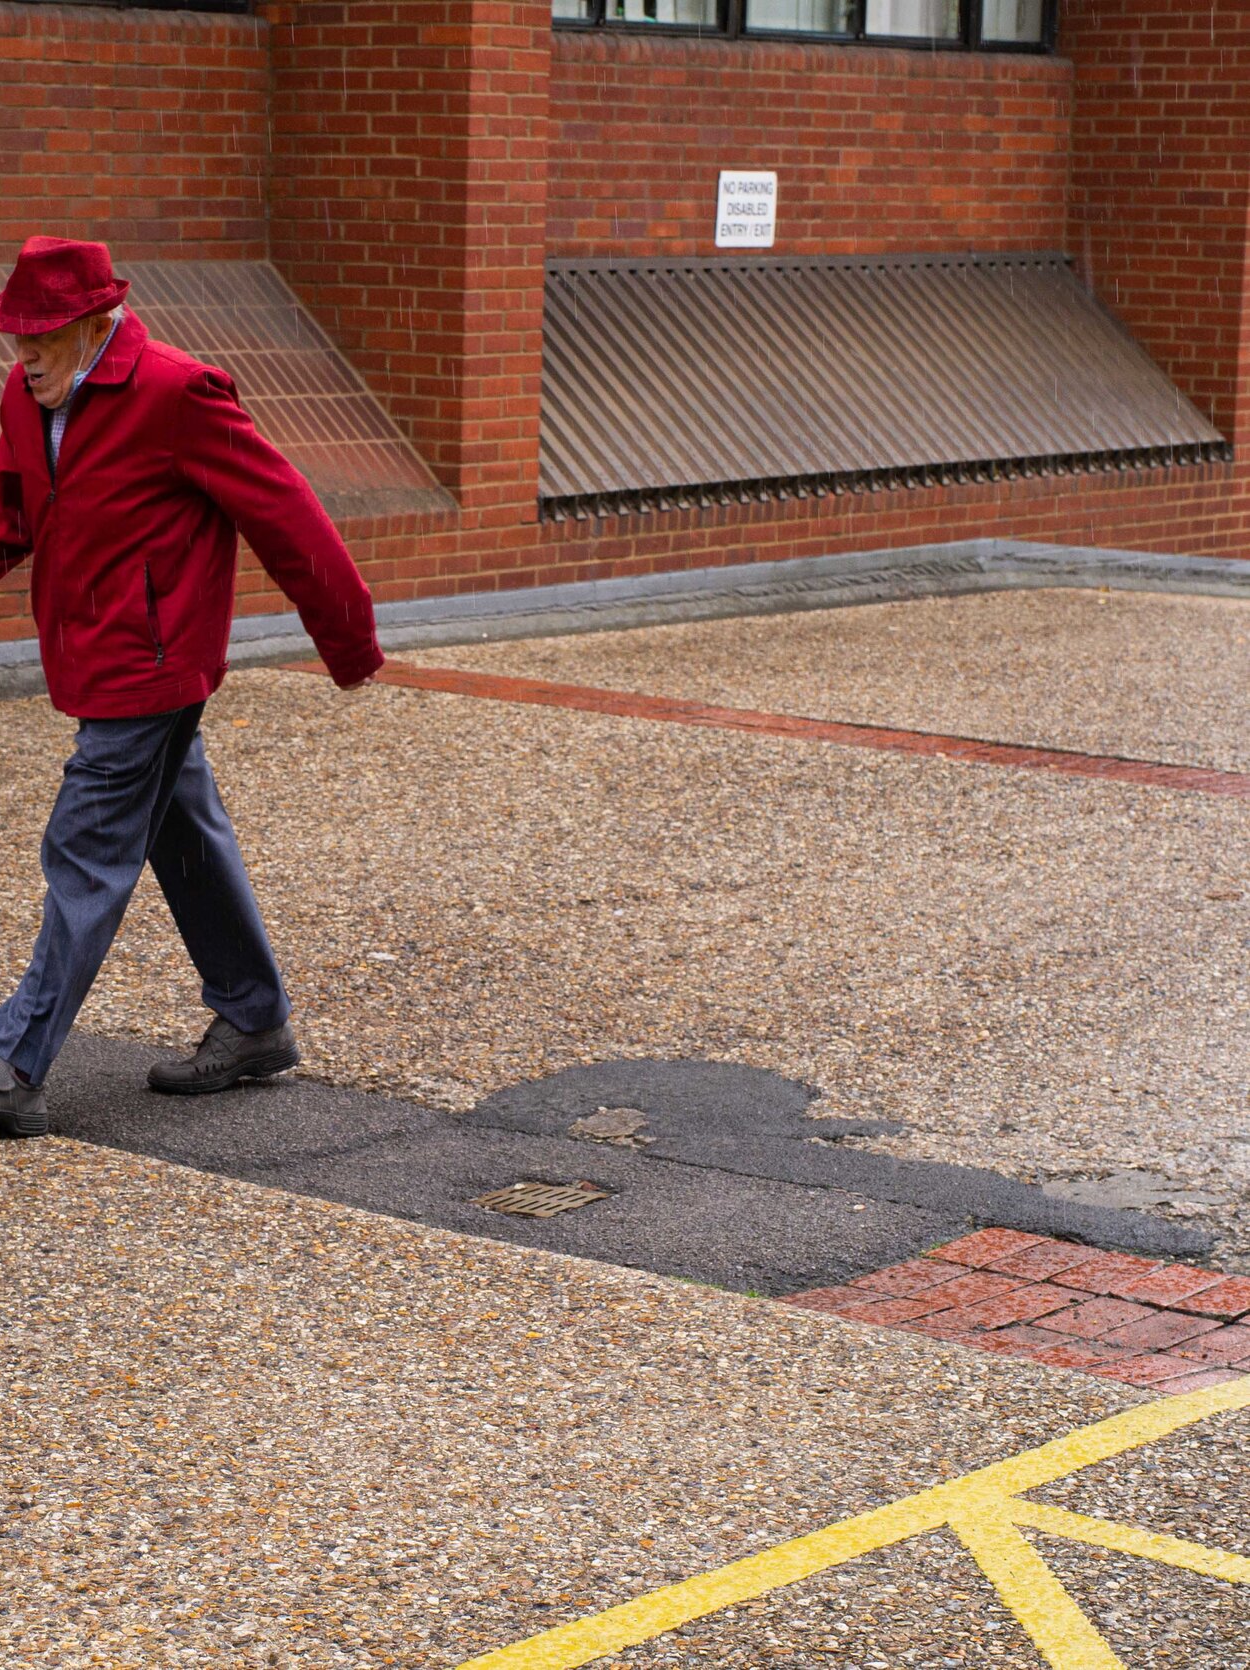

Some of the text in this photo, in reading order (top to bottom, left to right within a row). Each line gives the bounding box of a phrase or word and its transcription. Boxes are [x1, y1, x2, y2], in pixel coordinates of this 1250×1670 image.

[723, 181, 773, 195] NO PARKING
[727, 202, 768, 216] DISABLED
[720, 223, 747, 237] ENTRY
[754, 223, 771, 237] EXIT
